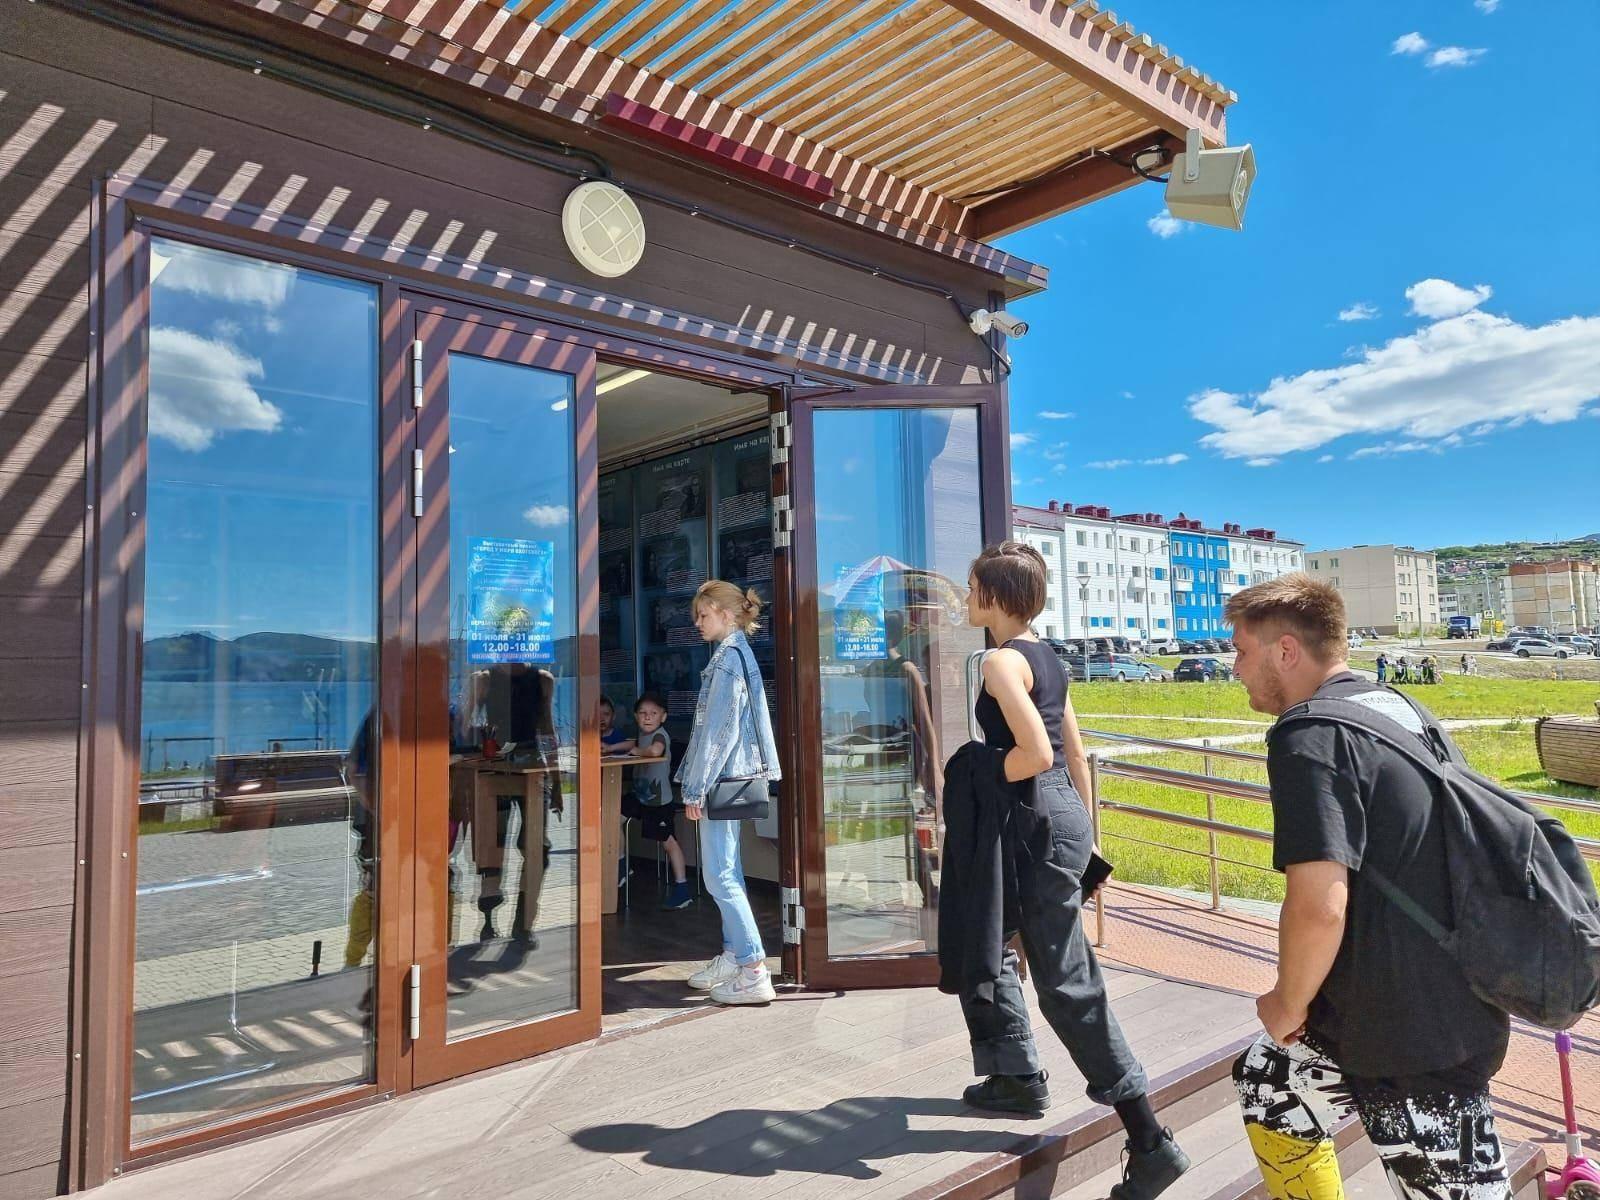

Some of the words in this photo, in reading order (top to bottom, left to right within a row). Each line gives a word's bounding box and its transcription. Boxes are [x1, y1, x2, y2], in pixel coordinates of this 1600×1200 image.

[471, 633, 482, 641] 01
[516, 633, 526, 641] 31
[482, 643, 540, 652] 12.00-18.00
